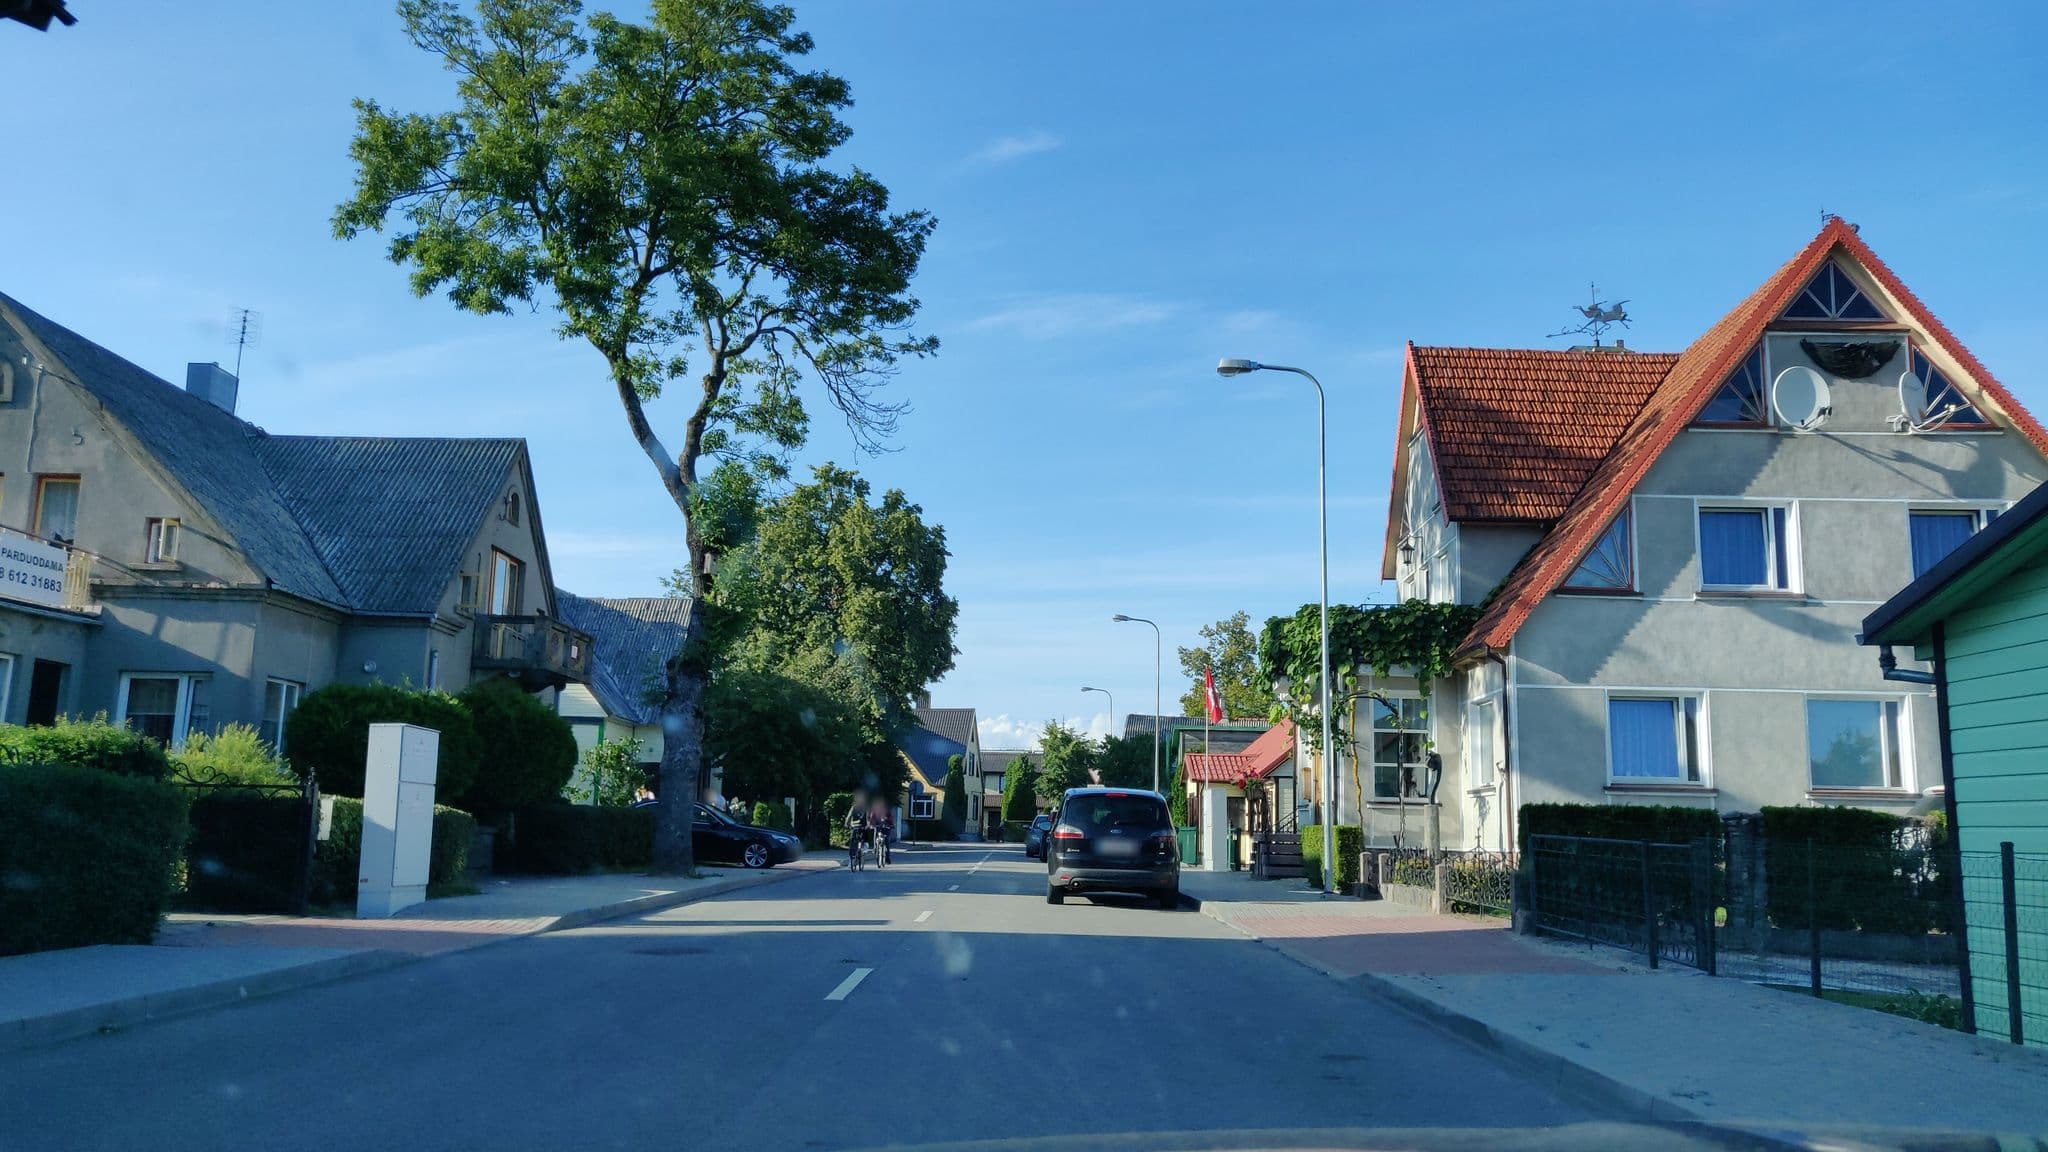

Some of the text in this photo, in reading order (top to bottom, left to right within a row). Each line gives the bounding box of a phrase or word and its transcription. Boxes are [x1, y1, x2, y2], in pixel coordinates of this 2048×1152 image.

[1, 547, 64, 572] PARDUODAMA
[8, 570, 28, 585] 612
[31, 575, 62, 592] 31883
